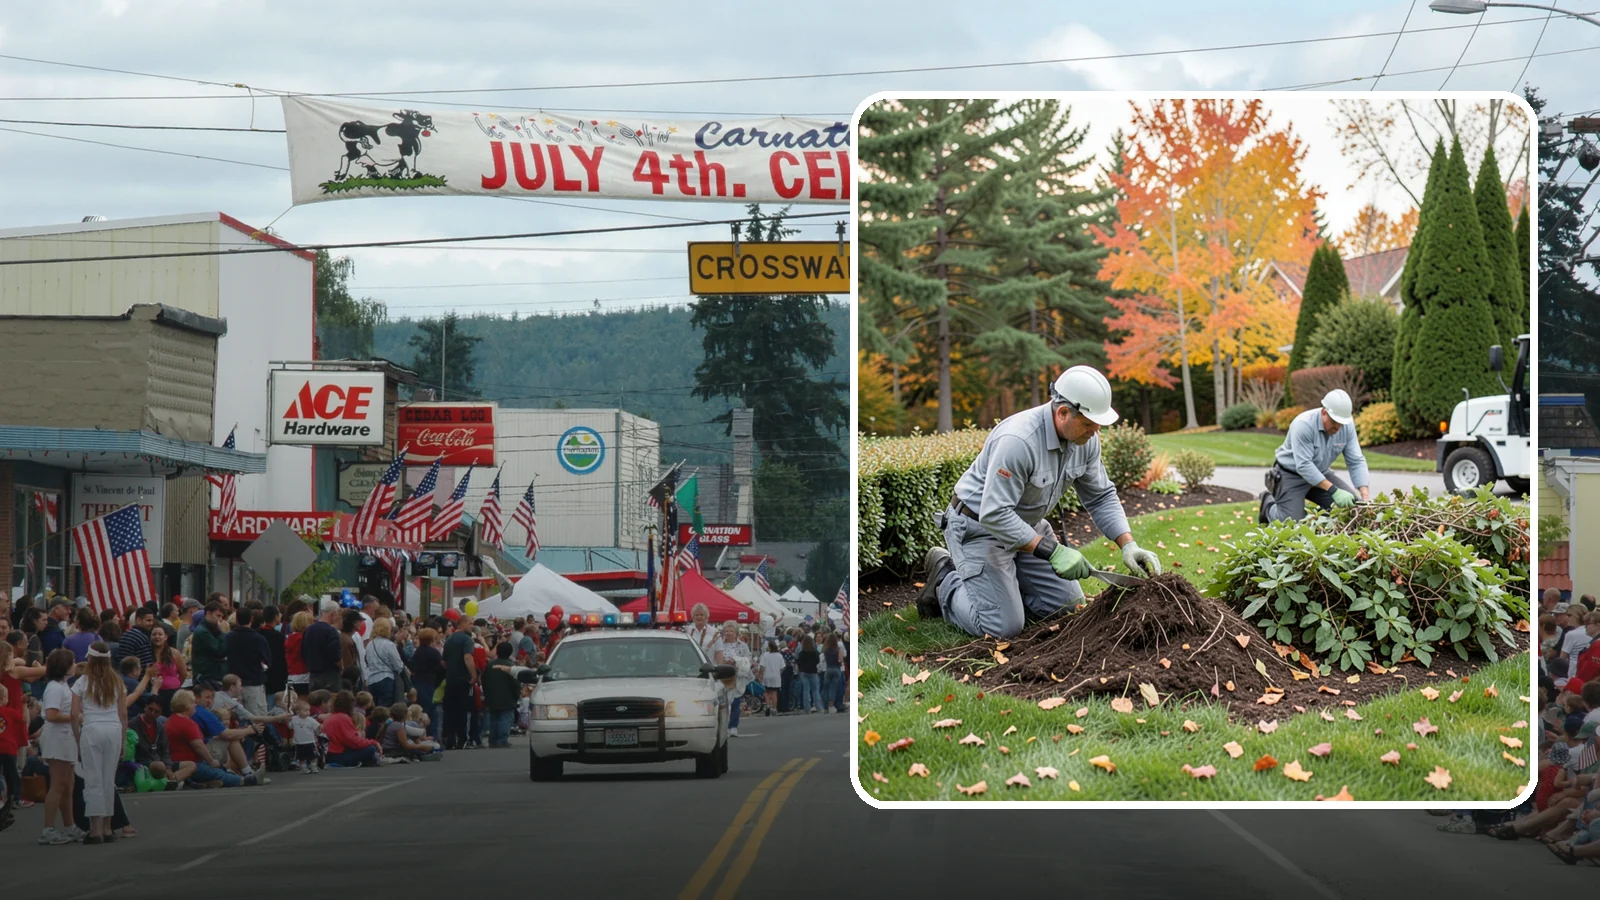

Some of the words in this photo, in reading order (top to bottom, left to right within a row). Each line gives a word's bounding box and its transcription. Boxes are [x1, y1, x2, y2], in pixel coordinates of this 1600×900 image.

[695, 122, 850, 149] Carnat
[481, 141, 604, 192] JULY
[632, 150, 746, 197] 4th.
[697, 254, 850, 280] CROSSWA
[283, 380, 373, 420] ACE
[406, 409, 453, 421] CEDAR
[284, 421, 370, 436] Hardware
[416, 428, 477, 447] Coca-Cola
[353, 467, 386, 480] Simpl
[83, 485, 94, 494] St.
[96, 485, 124, 494] Vincent
[126, 486, 135, 494] de
[138, 486, 155, 495] Paul
[688, 527, 741, 535] CRNATION
[699, 535, 730, 543] GLASS
